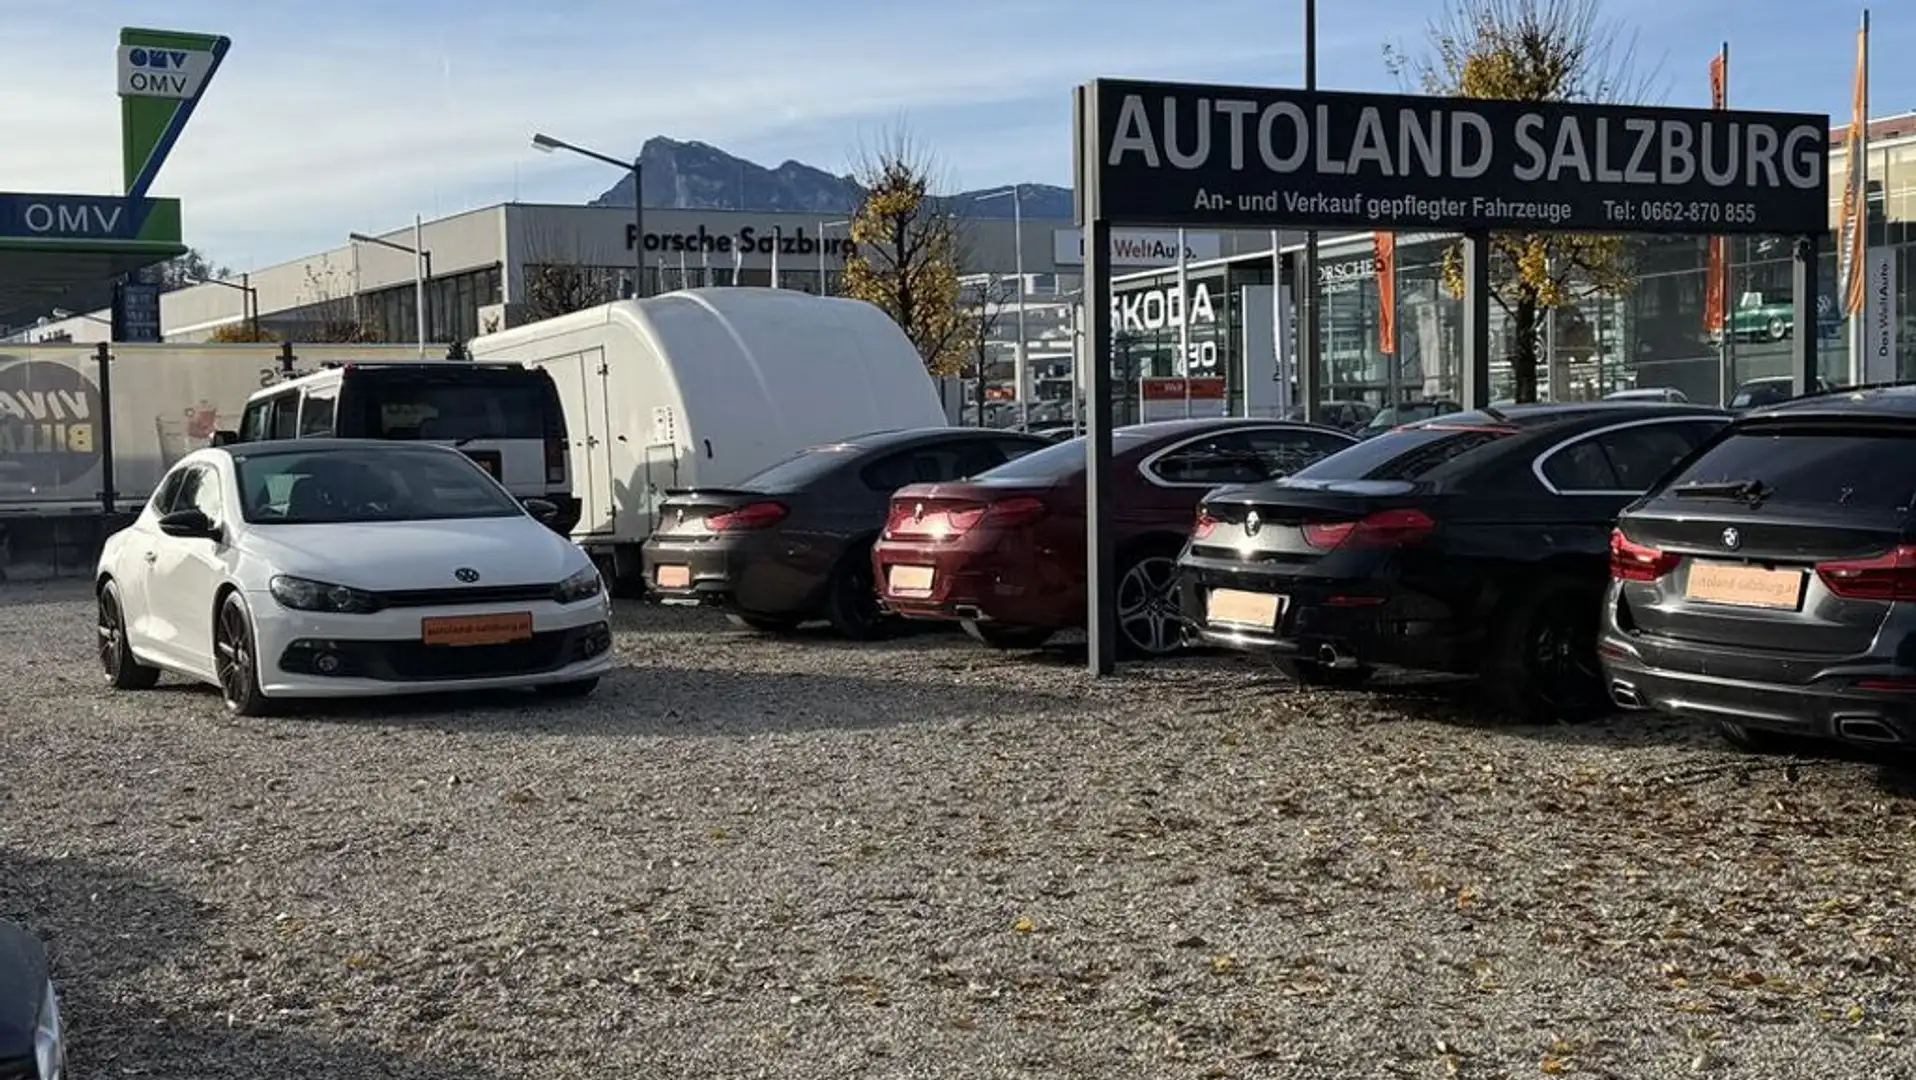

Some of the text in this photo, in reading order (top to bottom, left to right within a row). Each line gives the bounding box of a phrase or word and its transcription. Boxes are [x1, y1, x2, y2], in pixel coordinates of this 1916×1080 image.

[130, 73, 187, 93] OMV
[1108, 95, 1821, 189] AUTOLAND SALZBURG
[25, 203, 121, 233] OMV
[1194, 188, 1755, 223] An- und Verkauf gepflegter Fahrzeuge Tel: 0662-870 855
[626, 223, 730, 252] Porsche
